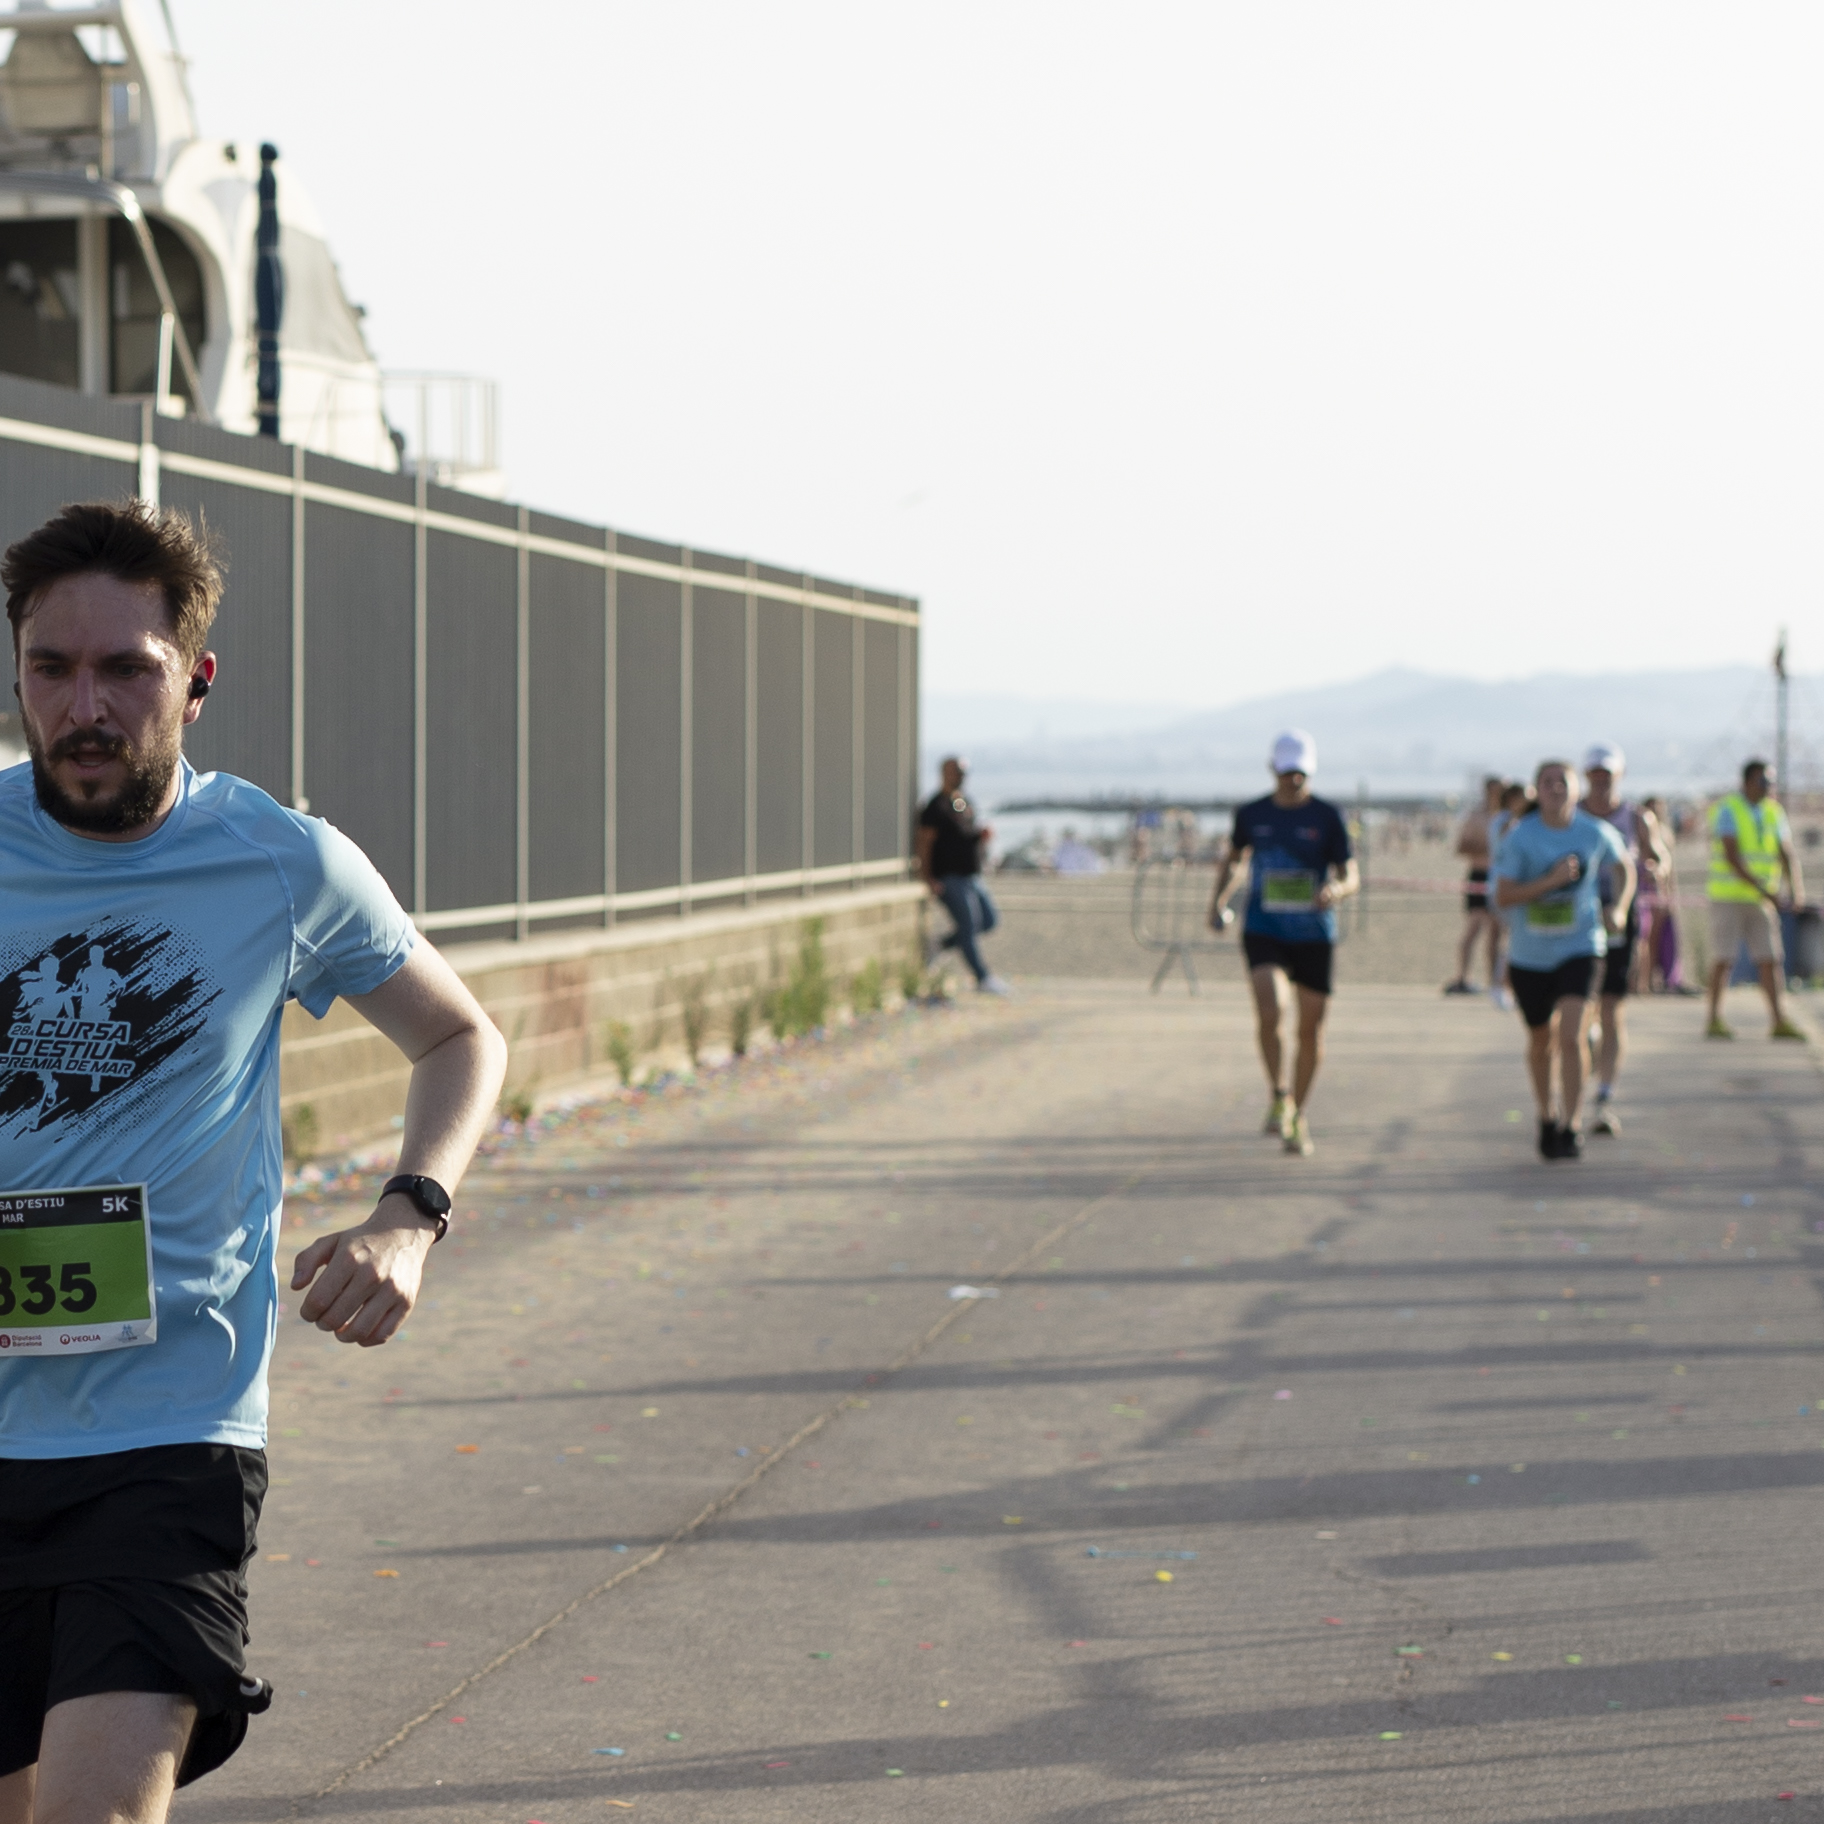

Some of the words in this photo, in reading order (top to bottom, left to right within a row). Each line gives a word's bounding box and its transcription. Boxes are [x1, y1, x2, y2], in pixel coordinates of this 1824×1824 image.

[36, 1019, 128, 1042] CURSA
[10, 1038, 113, 1060] D'ESTIU
[65, 1059, 90, 1072] DE
[90, 1061, 133, 1075] MAR
[16, 1197, 65, 1210] D'ESTIU
[102, 1196, 129, 1213] 5K
[2, 1212, 24, 1223] MAR
[71, 1334, 101, 1343] VEOLIA
